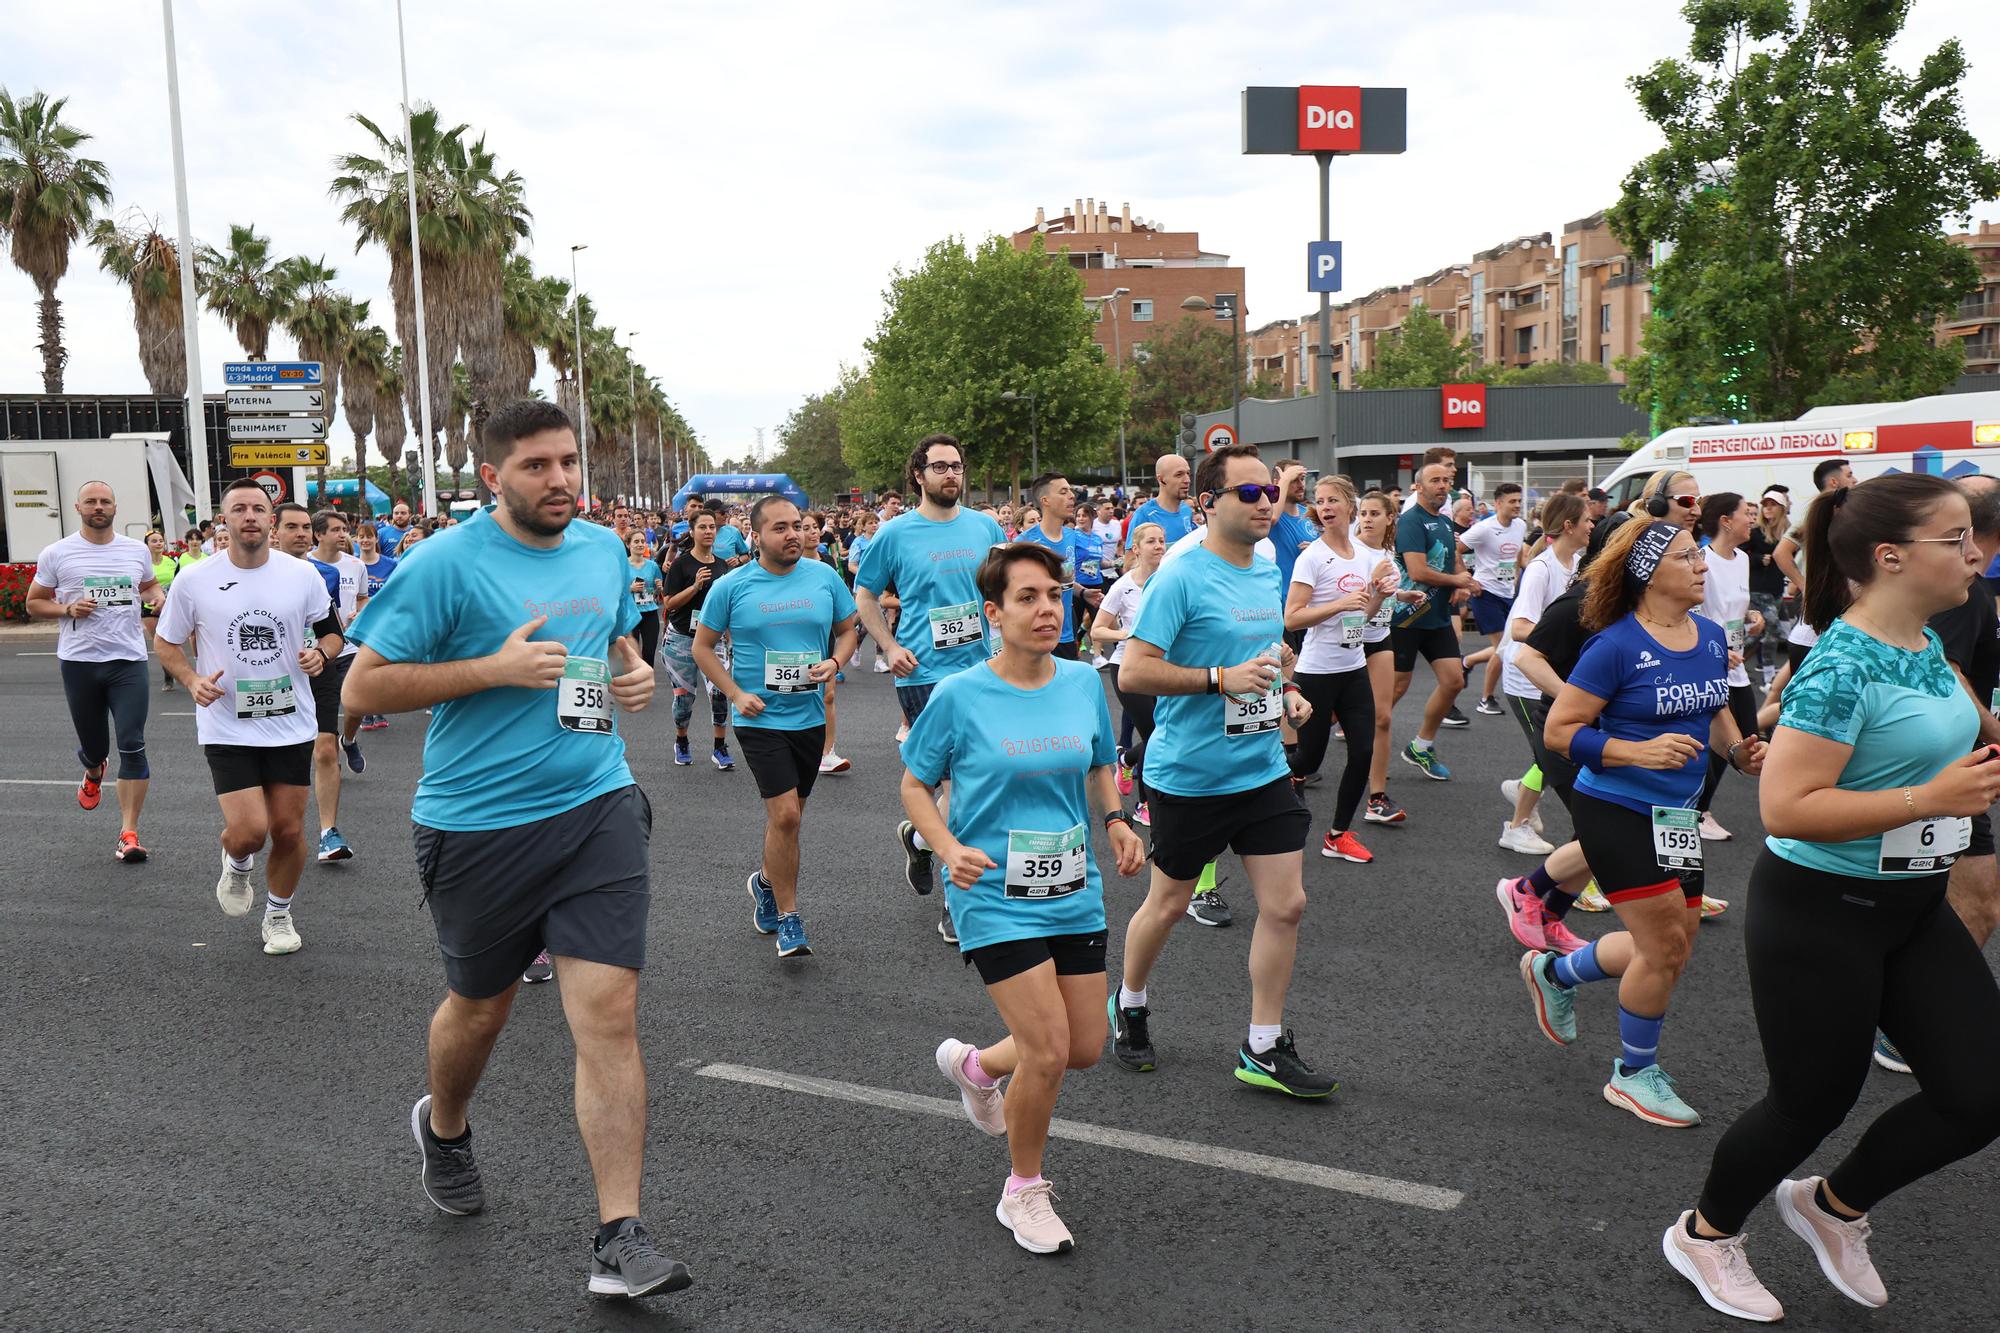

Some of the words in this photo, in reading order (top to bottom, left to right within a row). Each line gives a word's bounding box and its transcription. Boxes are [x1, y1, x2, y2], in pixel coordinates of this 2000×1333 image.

[1307, 105, 1353, 129] Dia
[1318, 254, 1335, 278] P
[1448, 397, 1481, 414] Dia
[230, 424, 287, 432] BENIMÀMET
[1636, 525, 1680, 580] SEVILLA
[340, 577, 354, 585] RA
[89, 588, 117, 598] 1703
[227, 611, 250, 644] BRITISH
[253, 609, 285, 638] COLLEGE
[940, 621, 964, 635] 362
[241, 640, 278, 651] BCLC
[303, 639, 313, 649] 2
[236, 653, 248, 663] LA
[1635, 659, 1661, 670] VIATOR
[774, 668, 800, 680] 364
[574, 687, 603, 709] 358
[1655, 678, 1730, 702] POBLATS
[246, 694, 274, 707] 346
[1238, 698, 1268, 717] 365
[1655, 692, 1730, 715] MARITIMS
[1659, 831, 1697, 850] 1593
[1920, 823, 1935, 846] 6
[1022, 859, 1063, 878] 359
[1910, 860, 1933, 868] 42K
